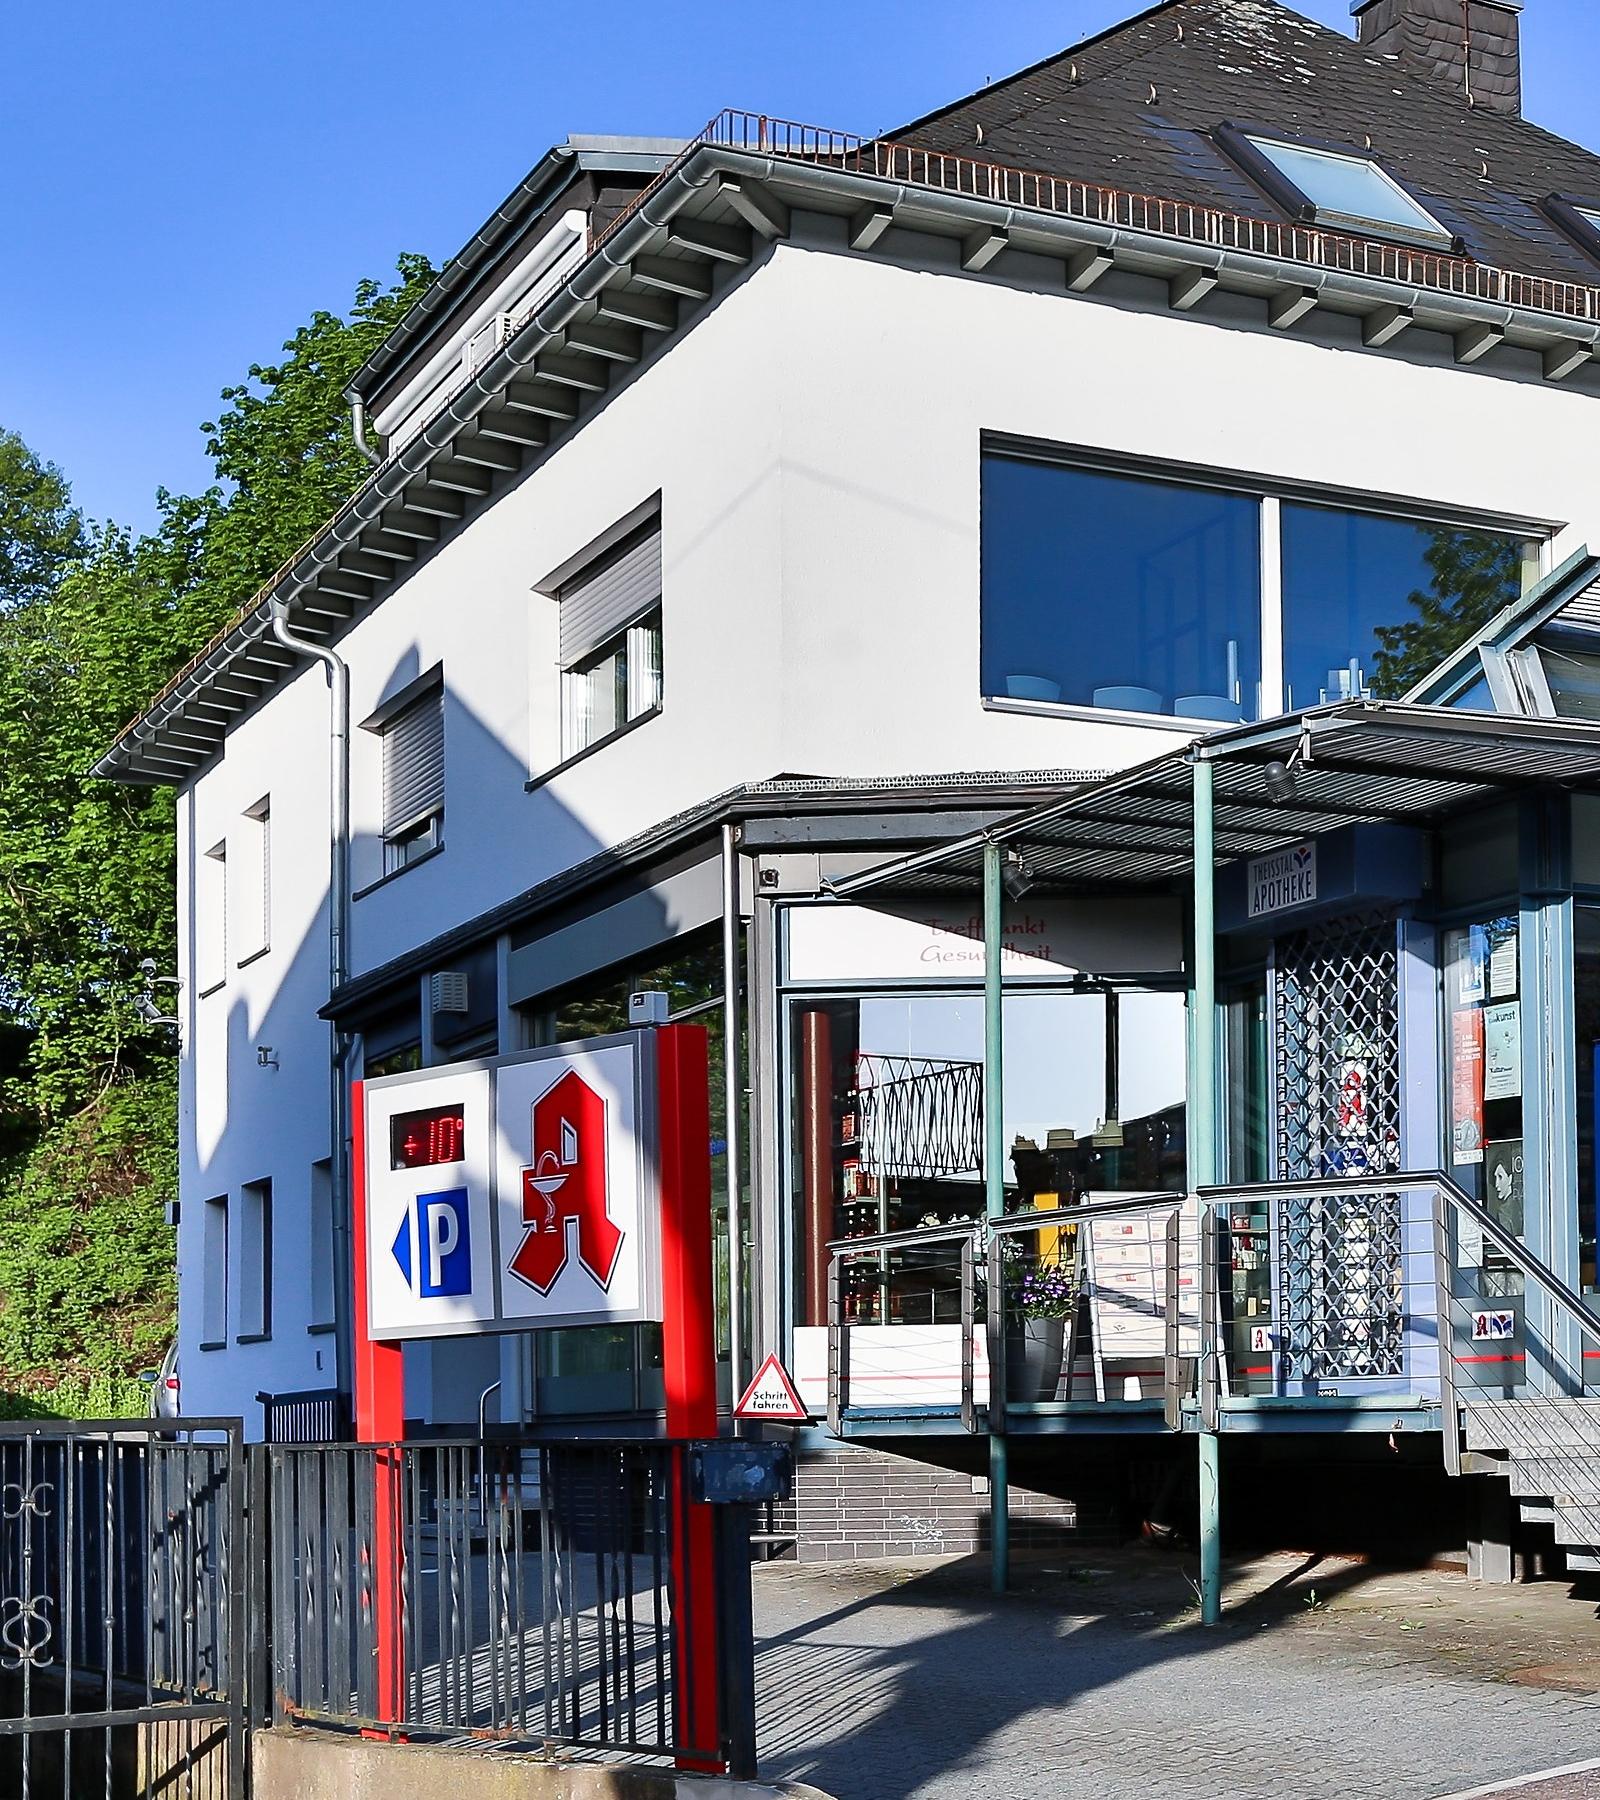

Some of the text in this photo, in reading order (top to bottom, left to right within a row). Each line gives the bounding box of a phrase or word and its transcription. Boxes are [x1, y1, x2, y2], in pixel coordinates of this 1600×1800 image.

[1253, 853, 1294, 883] THEISSTAL
[1254, 870, 1312, 912] APOTHEKE
[920, 943, 1053, 963] Gesudheit
[427, 1203, 459, 1287] P
[752, 1400, 788, 1410] fahren
[753, 1391, 787, 1400] Schritt
